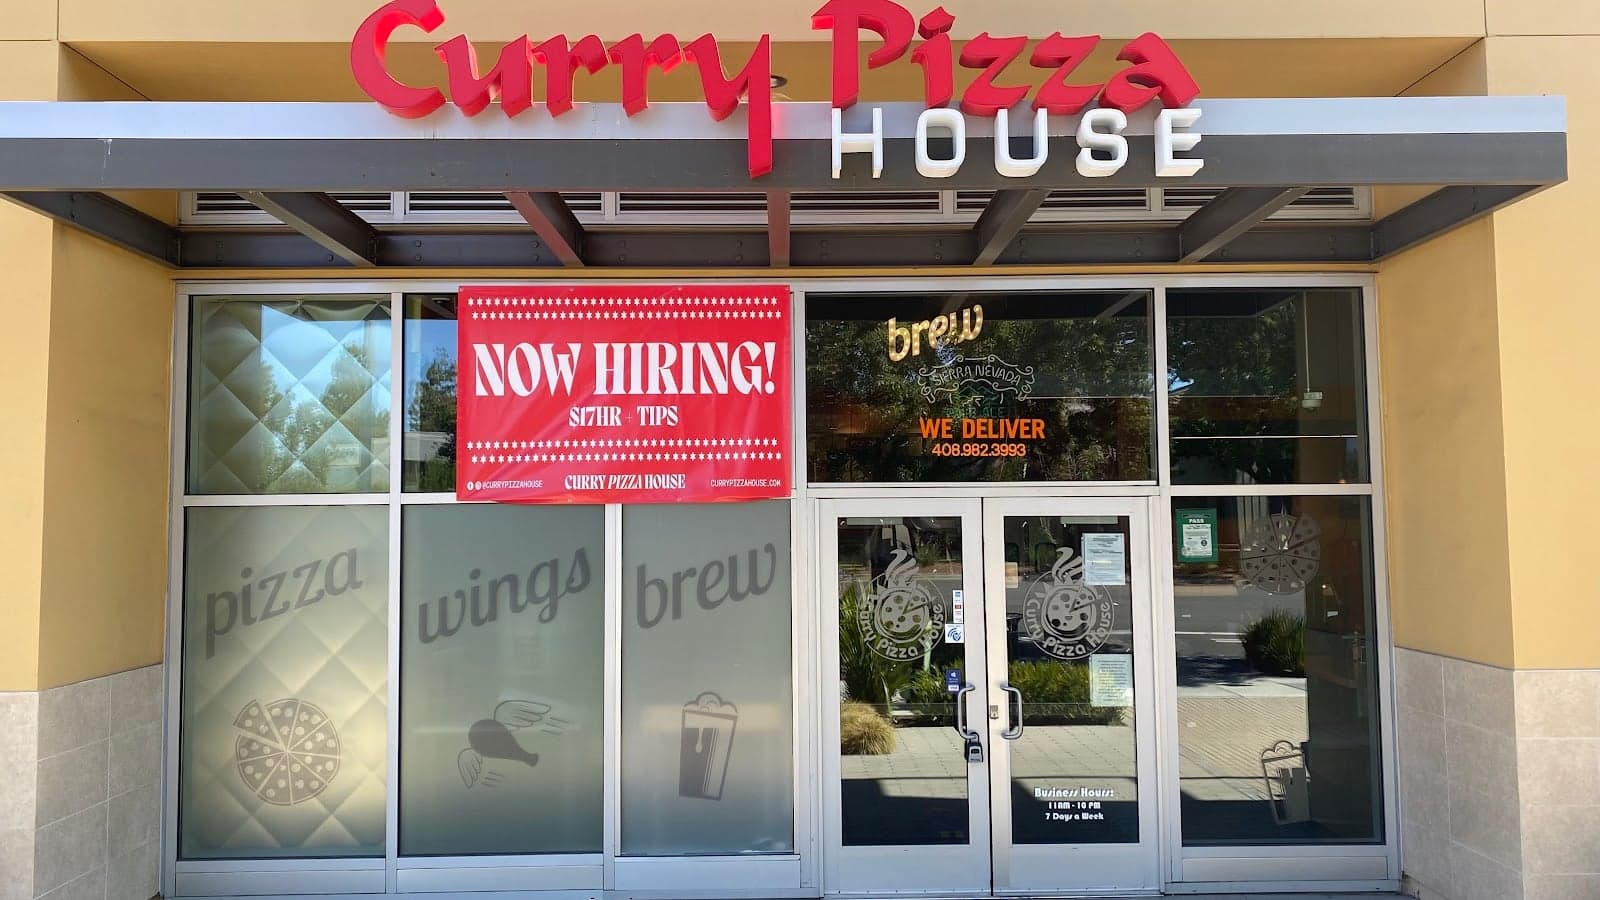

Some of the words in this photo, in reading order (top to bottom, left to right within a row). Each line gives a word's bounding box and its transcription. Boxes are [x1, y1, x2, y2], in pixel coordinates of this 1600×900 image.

[351, 0, 773, 178] Curry
[811, 0, 1201, 117] Pizza
[831, 107, 1205, 179] HOUSE
[887, 304, 984, 362] brew
[472, 342, 581, 397] NOW
[592, 341, 777, 396] HIRING!
[932, 365, 972, 386] SIERRA
[975, 364, 1021, 386] NEVADA
[568, 405, 622, 427] $17HR
[636, 405, 679, 427] TIPS
[920, 417, 953, 439] WE
[962, 418, 1046, 439] DELIVER
[931, 443, 1027, 457] 408.982.3993
[482, 480, 543, 489] @CURRYPIZZAHOUSE
[564, 474, 606, 490] CURRY
[607, 474, 642, 489] PIZZA
[644, 473, 686, 489] HOUSE
[710, 478, 781, 487] CURRYPIZZAHOUSE.COM
[416, 546, 592, 645] wings
[636, 542, 776, 629] brew
[205, 547, 363, 659] pizza
[1026, 598, 1044, 640] Curry
[1042, 636, 1087, 657] Pizza
[1086, 601, 1112, 648] House
[876, 638, 919, 659] Pizza
[1034, 787, 1078, 797] Business
[1080, 787, 1114, 797] Hours:
[1077, 801, 1087, 810] 10
[1088, 801, 1101, 810] PM
[1045, 812, 1051, 820] 7
[1052, 812, 1073, 822] Days
[1081, 812, 1104, 820] Week
